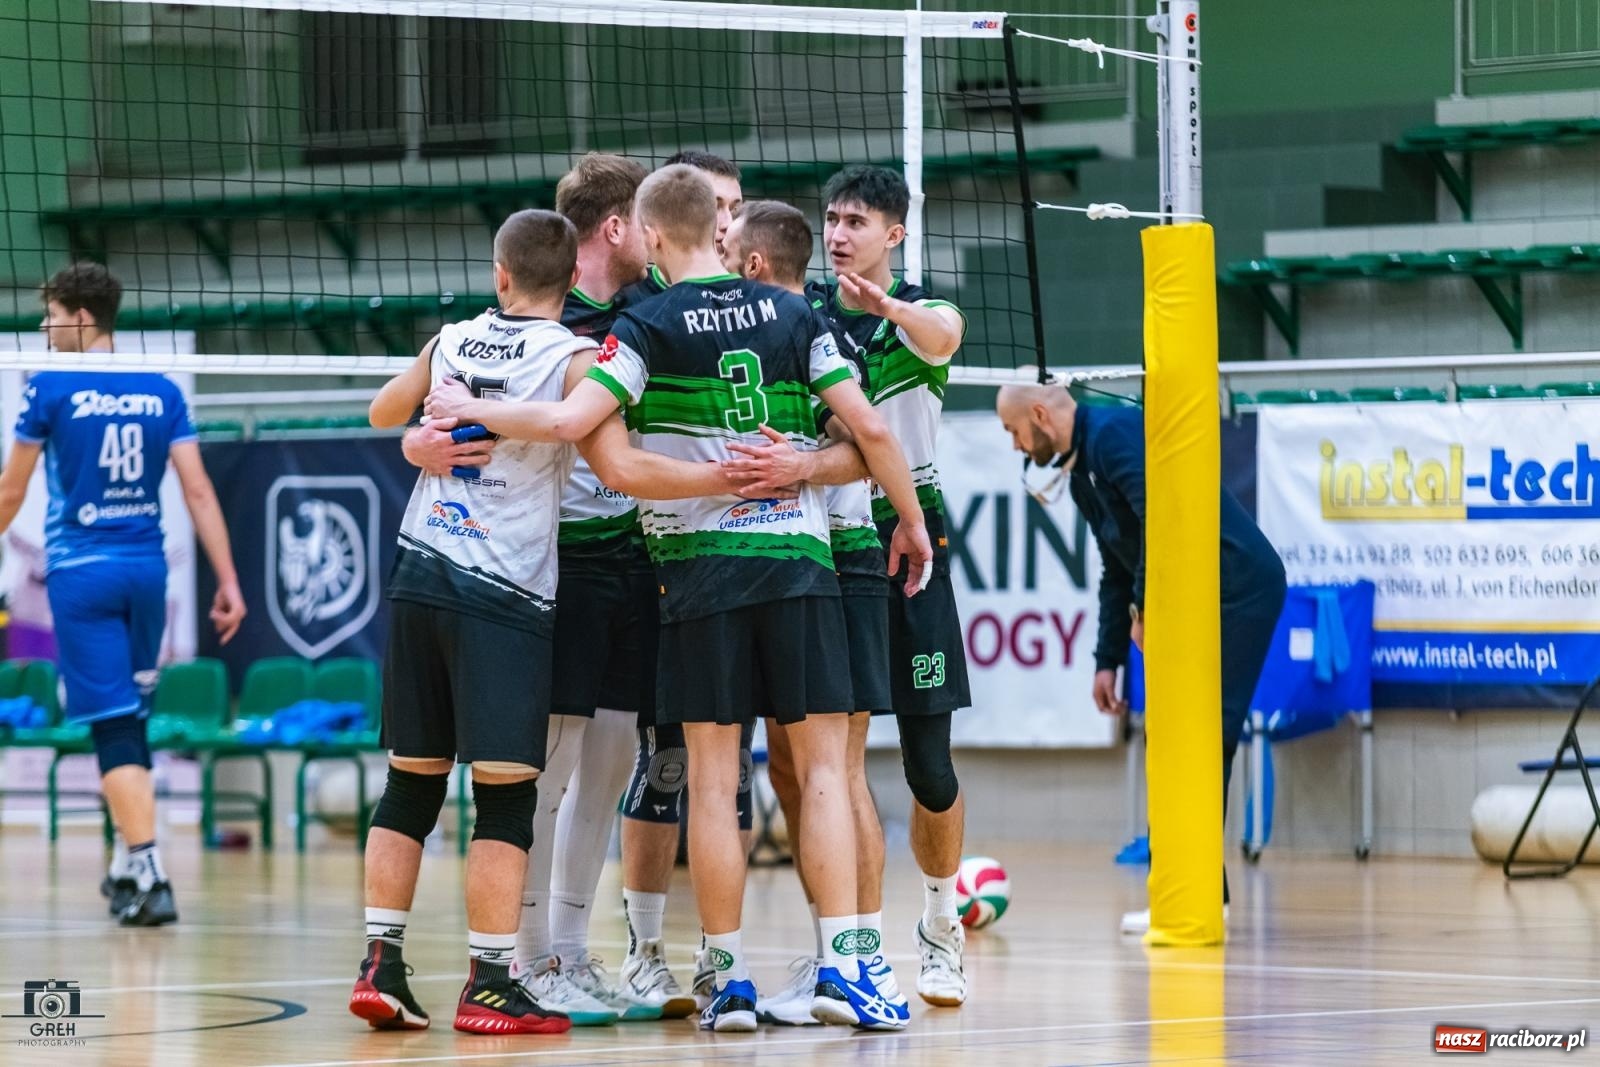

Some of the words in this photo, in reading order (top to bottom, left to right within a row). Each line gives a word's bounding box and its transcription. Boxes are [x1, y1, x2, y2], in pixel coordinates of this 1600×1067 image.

[972, 21, 998, 30] netex
[1189, 87, 1197, 156] sport
[683, 304, 756, 334] RZYTKI
[758, 298, 777, 322] M
[457, 337, 526, 360] KOSTKA
[718, 348, 768, 433] 3
[98, 422, 144, 483] 48
[1319, 438, 1600, 509] instal-tech
[719, 509, 804, 530] UBEZPIECZENIA
[941, 490, 1088, 592] XIN
[1458, 544, 1489, 567] 632
[1541, 544, 1573, 566] 606
[1377, 573, 1427, 600] cibórz,
[1472, 580, 1503, 599] von
[1508, 574, 1600, 599] Eichendor
[967, 610, 1087, 667] OGY
[912, 651, 946, 689] 23
